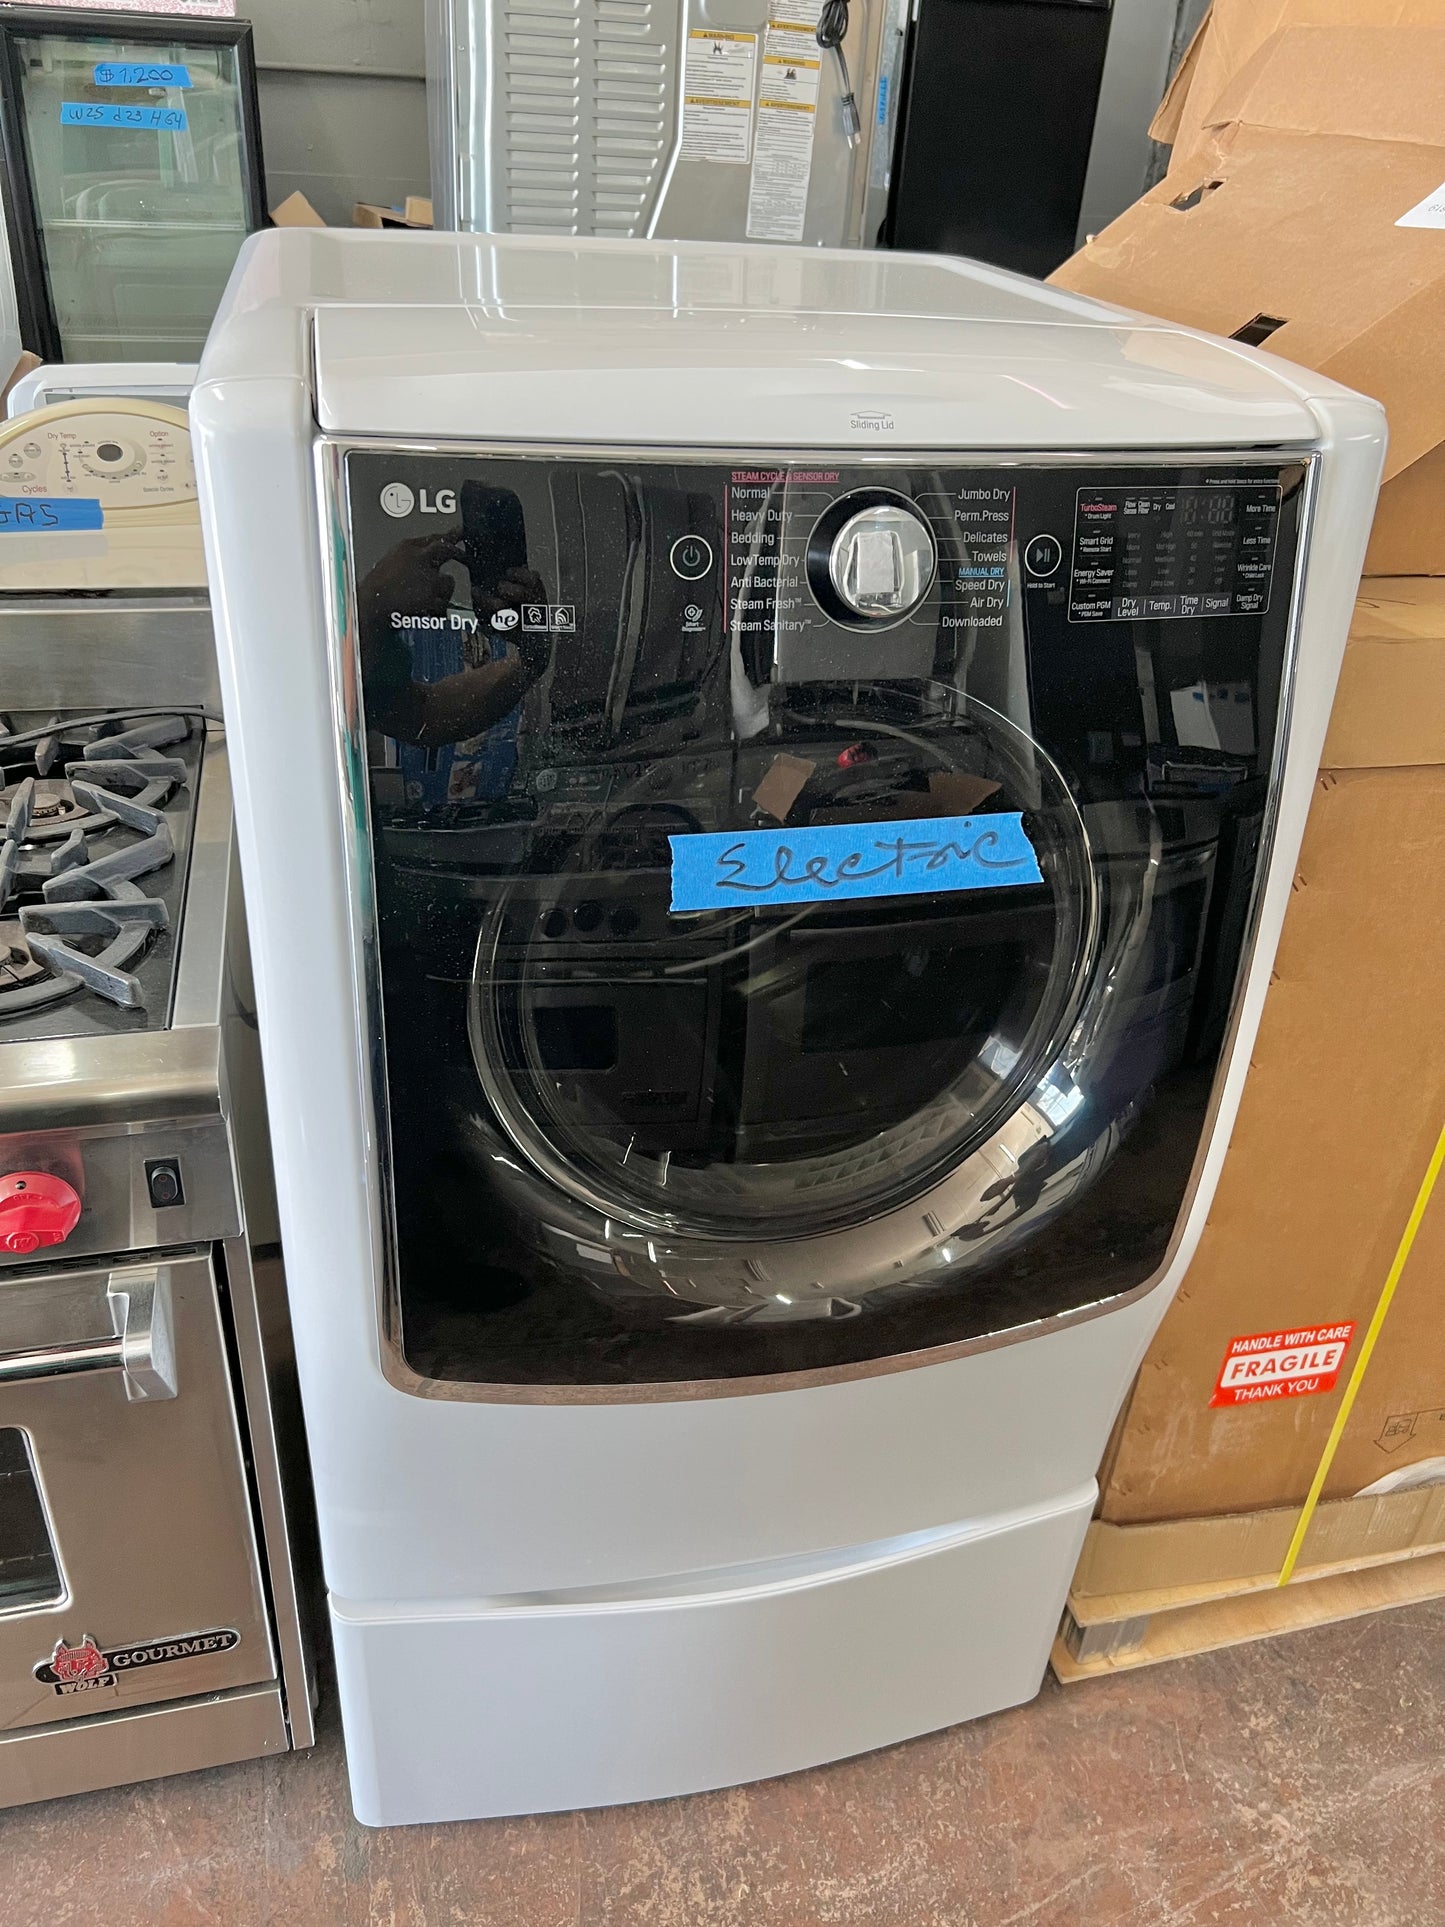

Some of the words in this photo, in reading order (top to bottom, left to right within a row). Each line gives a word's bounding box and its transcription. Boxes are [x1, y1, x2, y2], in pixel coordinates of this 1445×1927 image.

[850, 419, 880, 431] Sliding
[881, 420, 894, 430] Lid
[47, 432, 58, 440] Dry
[60, 432, 77, 440] Temp
[149, 430, 169, 438] Option
[731, 471, 759, 481] STEAM
[760, 471, 784, 481] CYCLE
[793, 471, 823, 481] SENSOR
[824, 471, 840, 481] DRY
[22, 485, 48, 495] Cycles
[731, 486, 771, 499] Normal
[957, 488, 991, 500] Jumbo
[993, 488, 1011, 502] Dry
[419, 489, 457, 514] LG
[1080, 503, 1117, 512] TurboSteam
[1246, 505, 1262, 513] More
[1262, 504, 1276, 512] Time
[731, 509, 766, 522] Heavy
[767, 509, 793, 524] Duty
[954, 509, 1009, 521] Perm.Press
[731, 531, 775, 546] Bedding
[963, 532, 1008, 543] Delicates
[1080, 537, 1099, 545] Smart
[1099, 536, 1114, 545] Grid
[1242, 537, 1257, 545] Less
[1257, 536, 1271, 545] Time
[783, 554, 800, 568] Dry
[971, 551, 1007, 562] Towels
[959, 567, 989, 576] MANUAL
[990, 567, 1005, 576] DRY
[1074, 569, 1095, 578] Energy
[1096, 568, 1114, 577] Saver
[1237, 564, 1258, 572] Wrinkle
[1259, 563, 1272, 571] Care
[731, 576, 752, 588] Anti
[754, 576, 798, 588] Bacterial
[955, 579, 986, 592] Speed
[987, 579, 1005, 593] Dry
[969, 597, 985, 608] Air
[986, 597, 1004, 610] Dry
[1121, 598, 1136, 608] Dry
[1180, 595, 1199, 605] Time
[1236, 594, 1252, 602] Damp
[1253, 593, 1263, 602] Dry
[730, 598, 764, 610] Steam
[1071, 602, 1095, 610] Custom
[1096, 601, 1111, 610] PGM
[1149, 600, 1173, 612] Temp.
[1181, 604, 1196, 615] Dry
[1205, 598, 1229, 610] Signal
[1240, 602, 1259, 610] Signal
[1117, 606, 1139, 617] Level
[390, 611, 446, 630] Sensor
[450, 612, 478, 634] Dry
[730, 619, 762, 632] Steam
[942, 616, 1003, 628] Downloaded
[715, 820, 1028, 892] Electric
[1231, 1334, 1283, 1354] HANDLE
[1284, 1330, 1315, 1346] WITH
[1317, 1325, 1352, 1341] CARE
[1230, 1349, 1338, 1380] FRAGILE
[1234, 1382, 1285, 1401] THANK
[1287, 1378, 1320, 1393] YOU
[112, 1633, 233, 1667] GOURMET
[59, 1676, 110, 1694] WOLF
